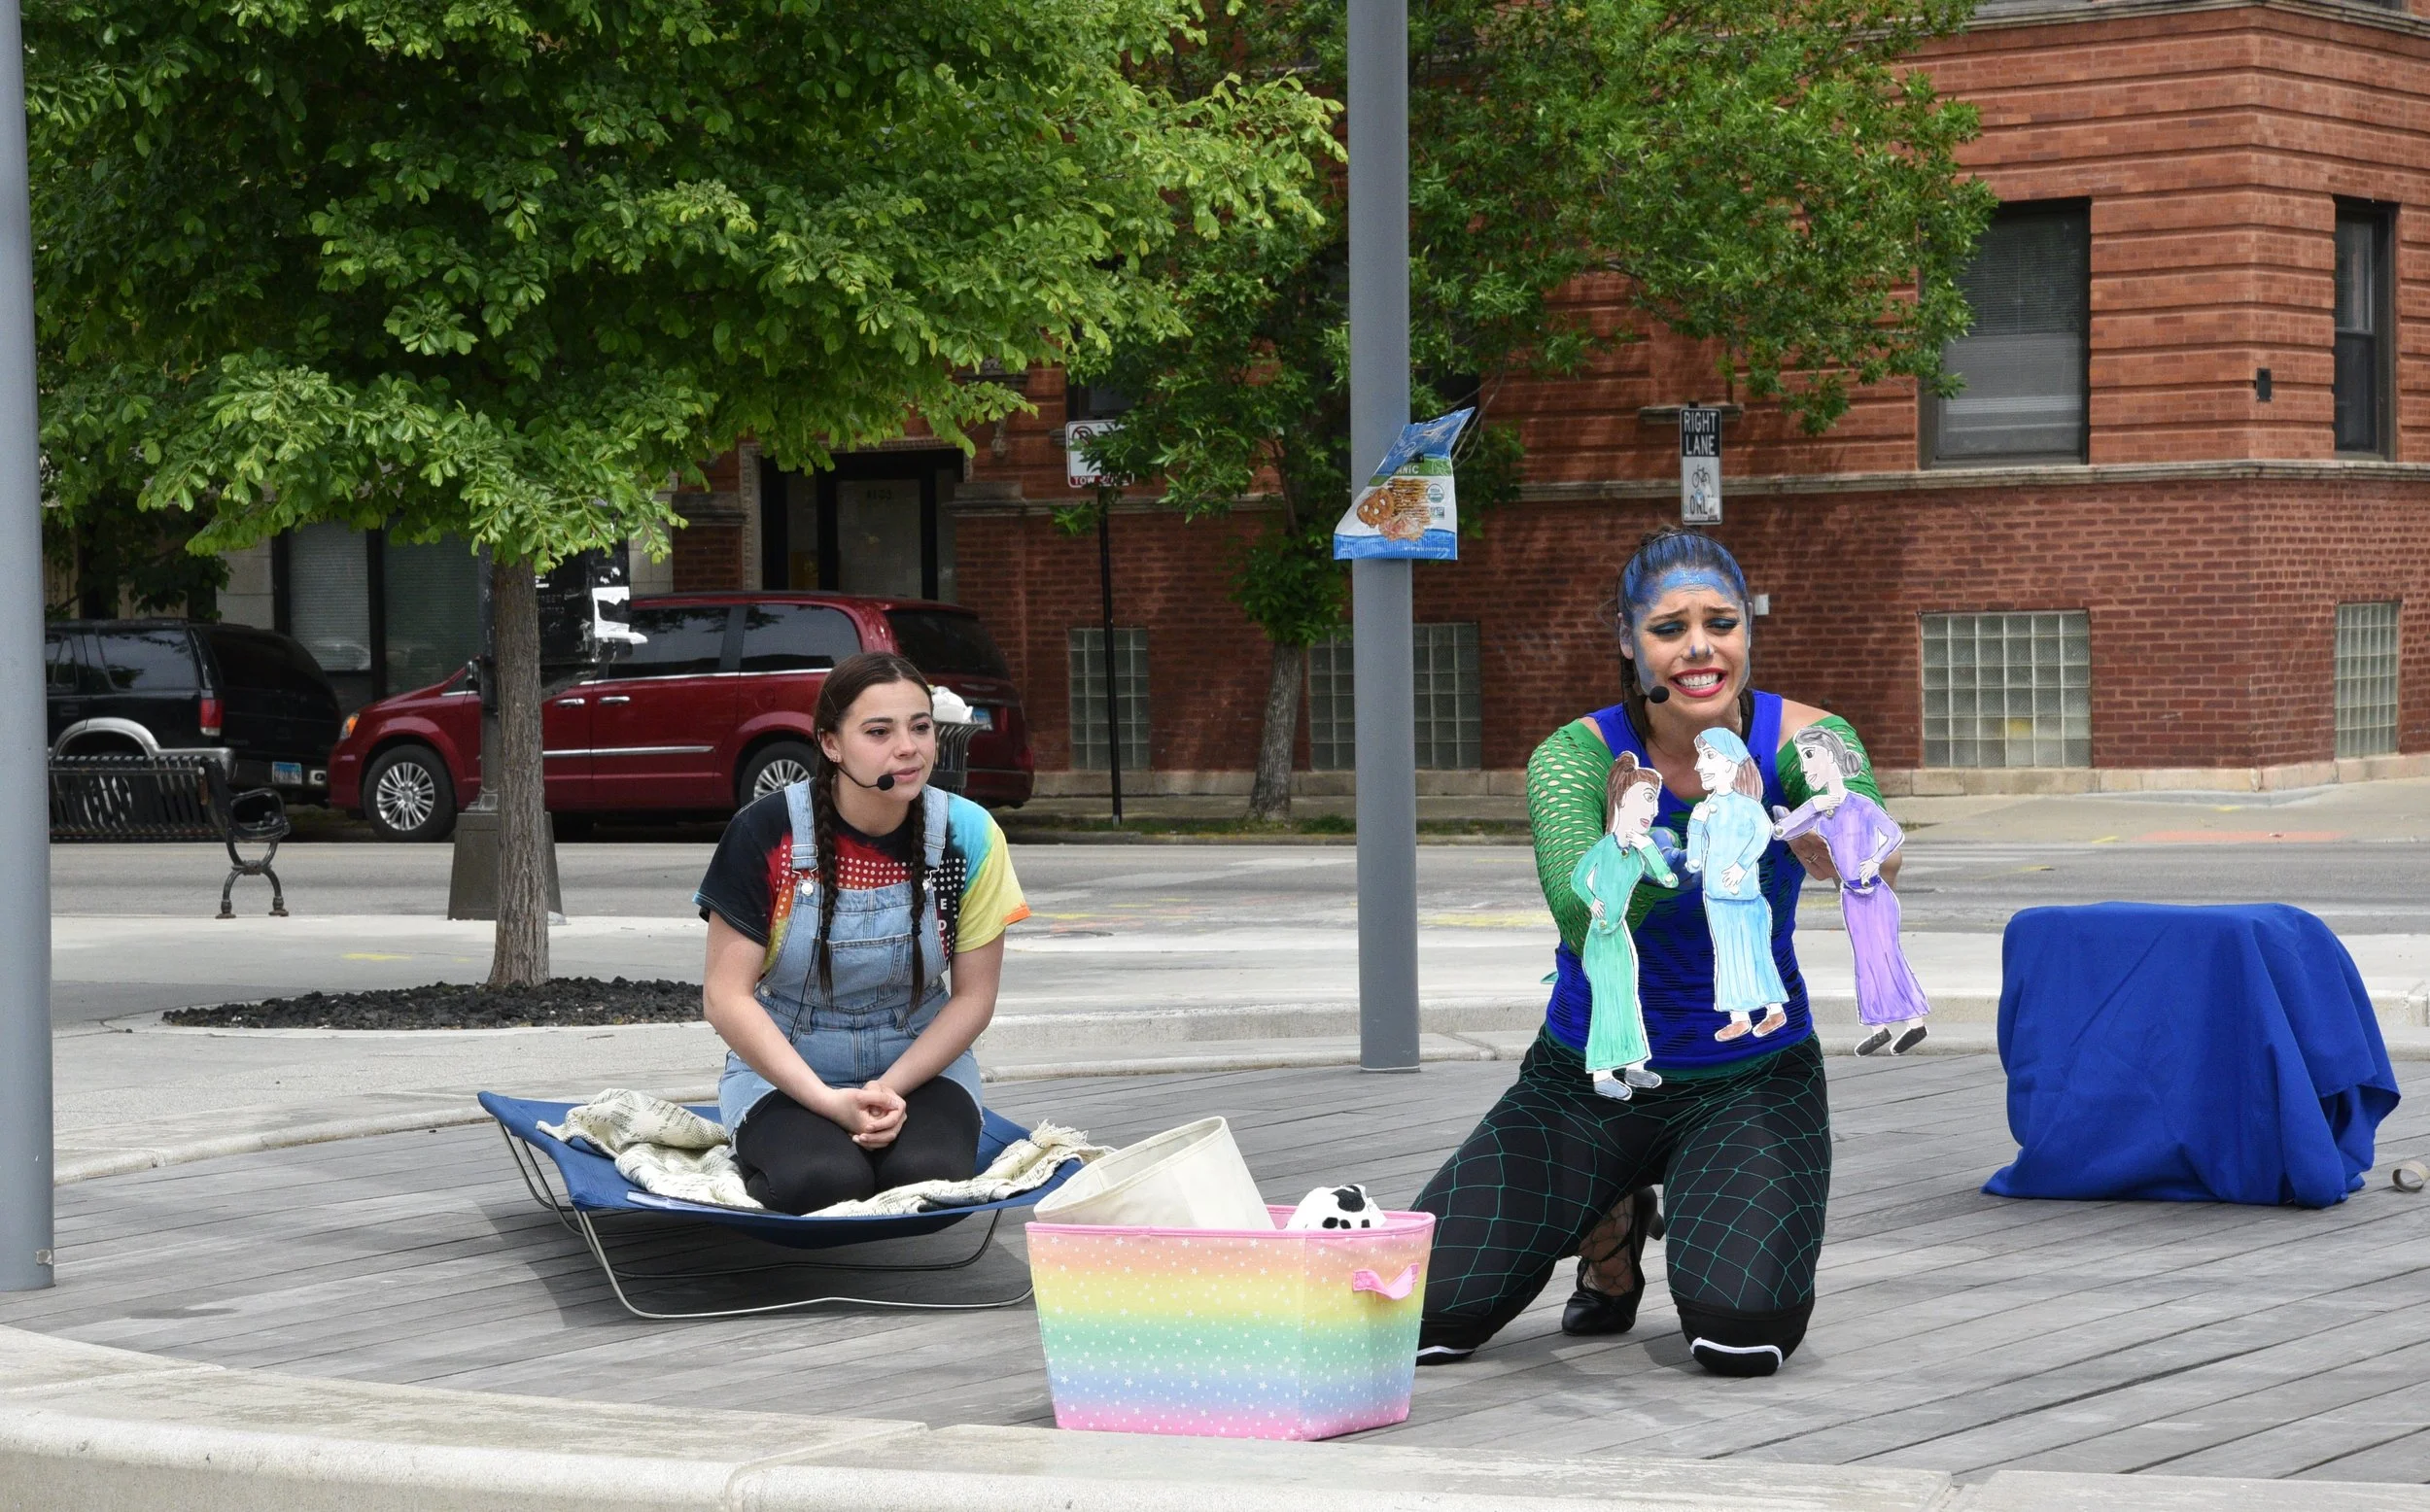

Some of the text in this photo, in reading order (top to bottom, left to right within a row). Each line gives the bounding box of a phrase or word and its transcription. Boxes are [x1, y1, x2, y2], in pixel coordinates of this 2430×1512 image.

[1684, 412, 1717, 433] RIGHT
[1685, 434, 1716, 456] LANE
[1073, 476, 1095, 486] TOW
[1689, 495, 1714, 515] ONL
